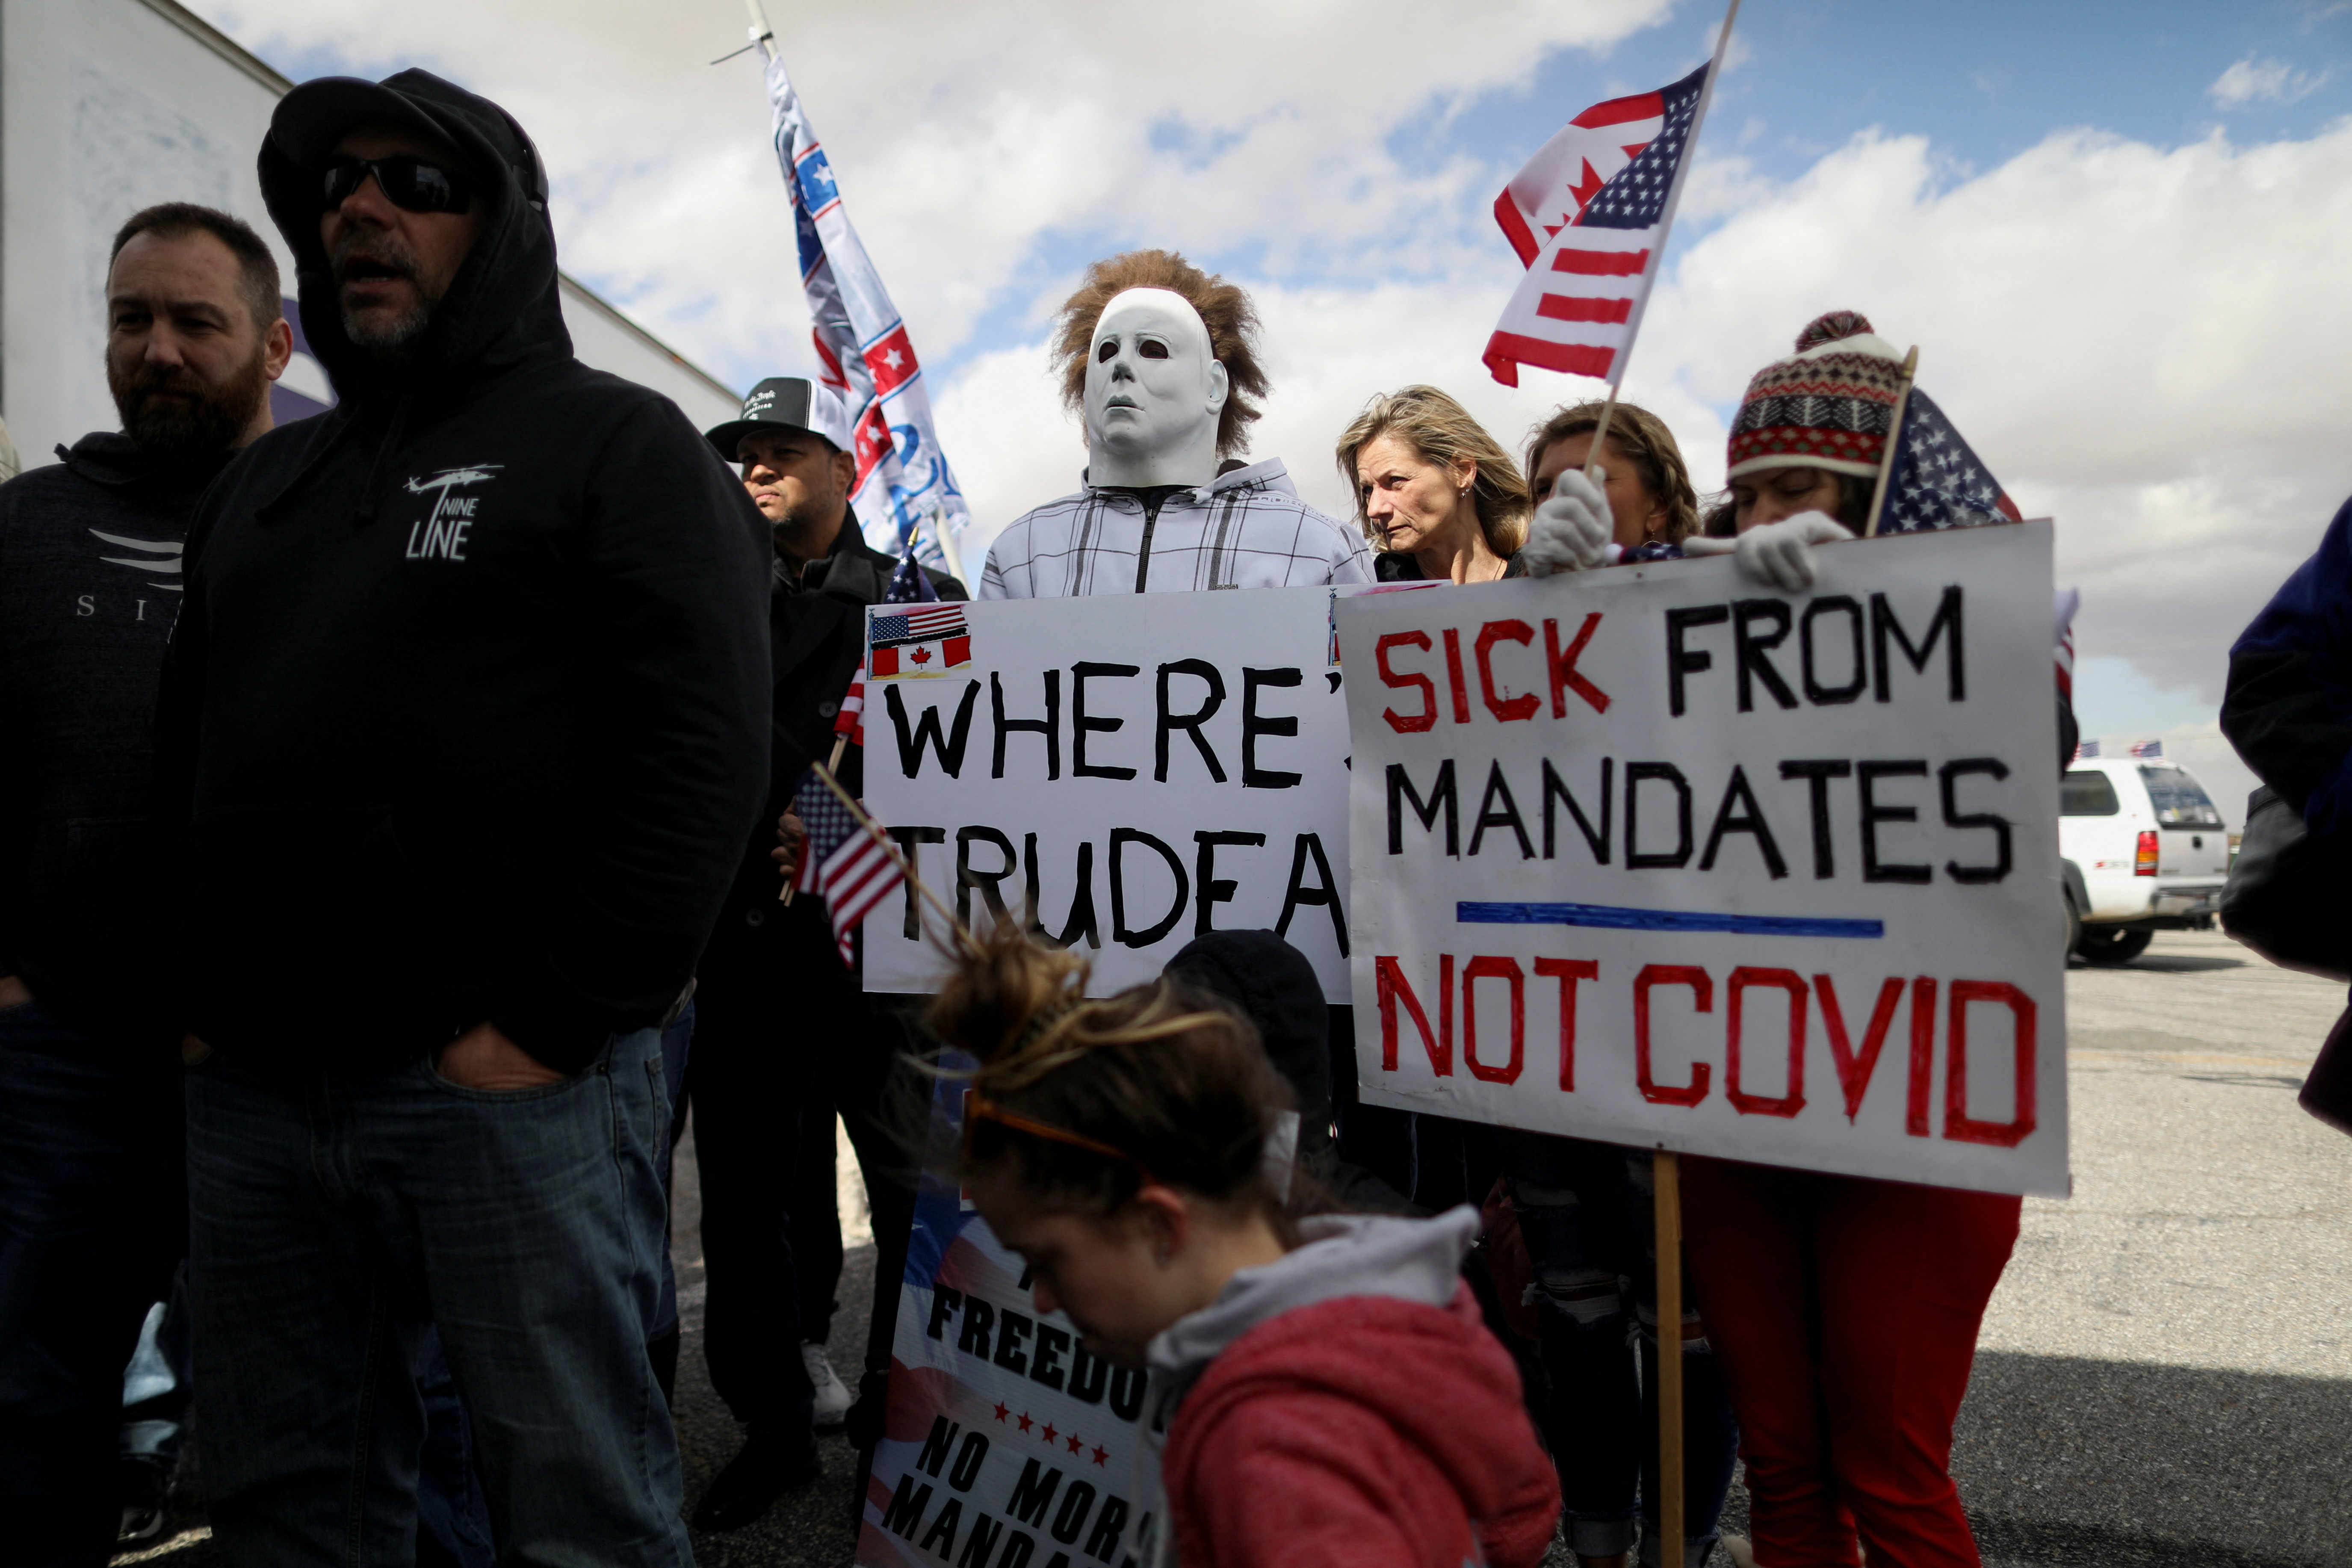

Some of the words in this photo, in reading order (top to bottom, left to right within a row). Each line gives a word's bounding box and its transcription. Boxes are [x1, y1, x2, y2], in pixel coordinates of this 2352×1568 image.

[406, 519, 472, 561] LINE
[440, 498, 479, 516] NINE
[883, 658, 1350, 789] WHERE'
[1375, 612, 1611, 734] SICK
[1665, 583, 1966, 718] FROM
[1385, 756, 2015, 886] MANDATES
[883, 825, 1350, 960] TRUDEA
[1375, 954, 1599, 1093] NOT
[1634, 965, 2037, 1148] COVID
[927, 1284, 1164, 1432] FREEDO
[916, 1414, 990, 1493] NO
